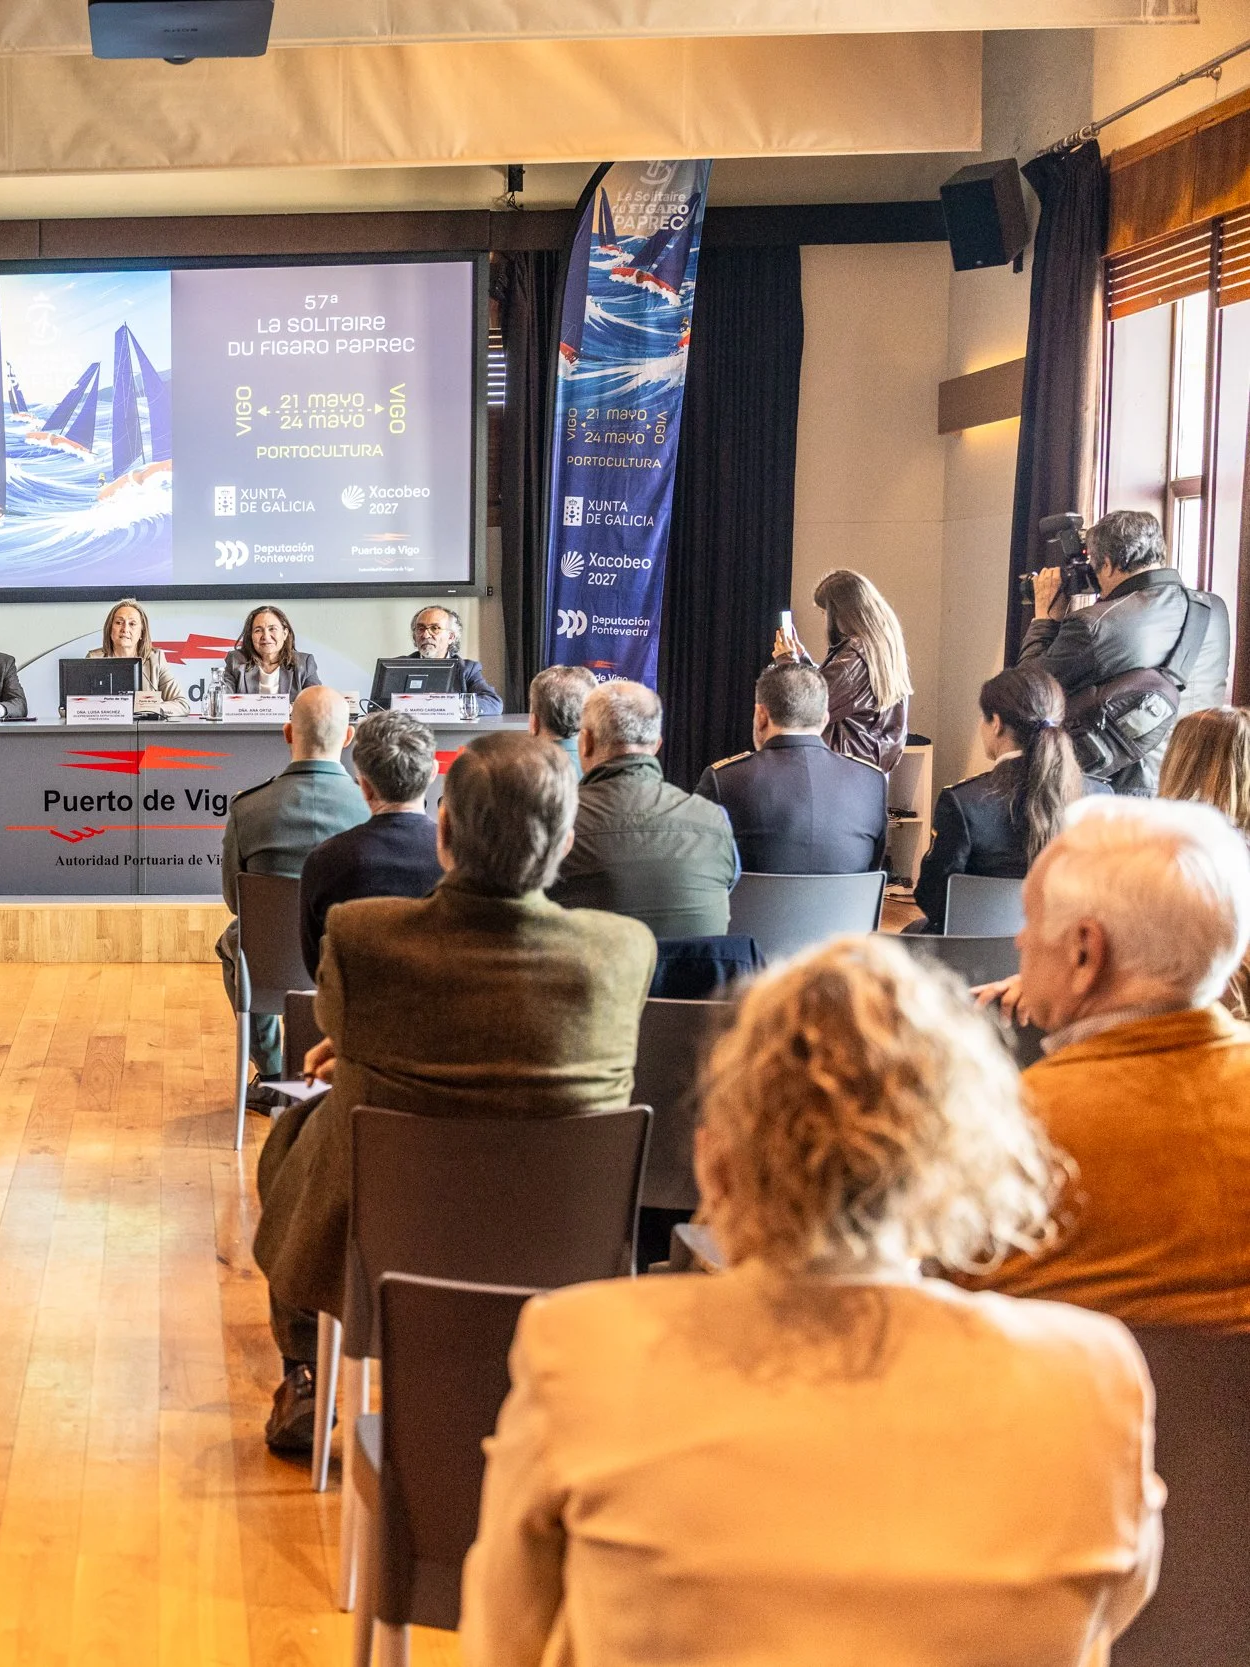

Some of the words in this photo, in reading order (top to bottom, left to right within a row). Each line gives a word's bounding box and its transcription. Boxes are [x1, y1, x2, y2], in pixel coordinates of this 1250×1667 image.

[618, 191, 632, 201] La
[634, 190, 686, 202] Solitaire
[629, 203, 689, 215] FIGARO
[614, 215, 684, 231] PAPREC
[228, 341, 253, 356] DU
[280, 394, 298, 408] 21
[236, 386, 252, 436] VIGO
[389, 383, 406, 434] VIGO
[586, 408, 600, 420] 21
[280, 415, 303, 429] 24
[567, 407, 578, 441] VIGO
[654, 410, 668, 444] VIGO
[584, 431, 601, 443] 24
[257, 444, 384, 459] PORTOCULTURA
[566, 456, 662, 469] PORTOCULTURA
[240, 488, 286, 500] XUNTA
[369, 484, 431, 498] Xacobeo
[240, 501, 257, 513] DE
[261, 500, 316, 513] GALICIA
[369, 502, 399, 515] 2027
[587, 499, 628, 512] XUNTA
[586, 513, 601, 525] DE
[604, 514, 655, 527] GALICIA
[254, 542, 314, 555] Deputación
[351, 546, 383, 555] Puerto
[384, 546, 396, 555] de
[398, 545, 420, 557] Vigo
[254, 553, 314, 563] Pontevedra
[588, 552, 652, 570] Xacobeo
[587, 572, 617, 586] 2027
[592, 615, 650, 627] Deputación
[591, 625, 649, 637] Pontevedra
[44, 789, 133, 812] Puerto
[143, 789, 175, 811] de
[184, 788, 227, 817] Vig
[55, 855, 119, 866] Autoridad
[124, 855, 184, 866] Portuaria
[188, 854, 203, 866] de
